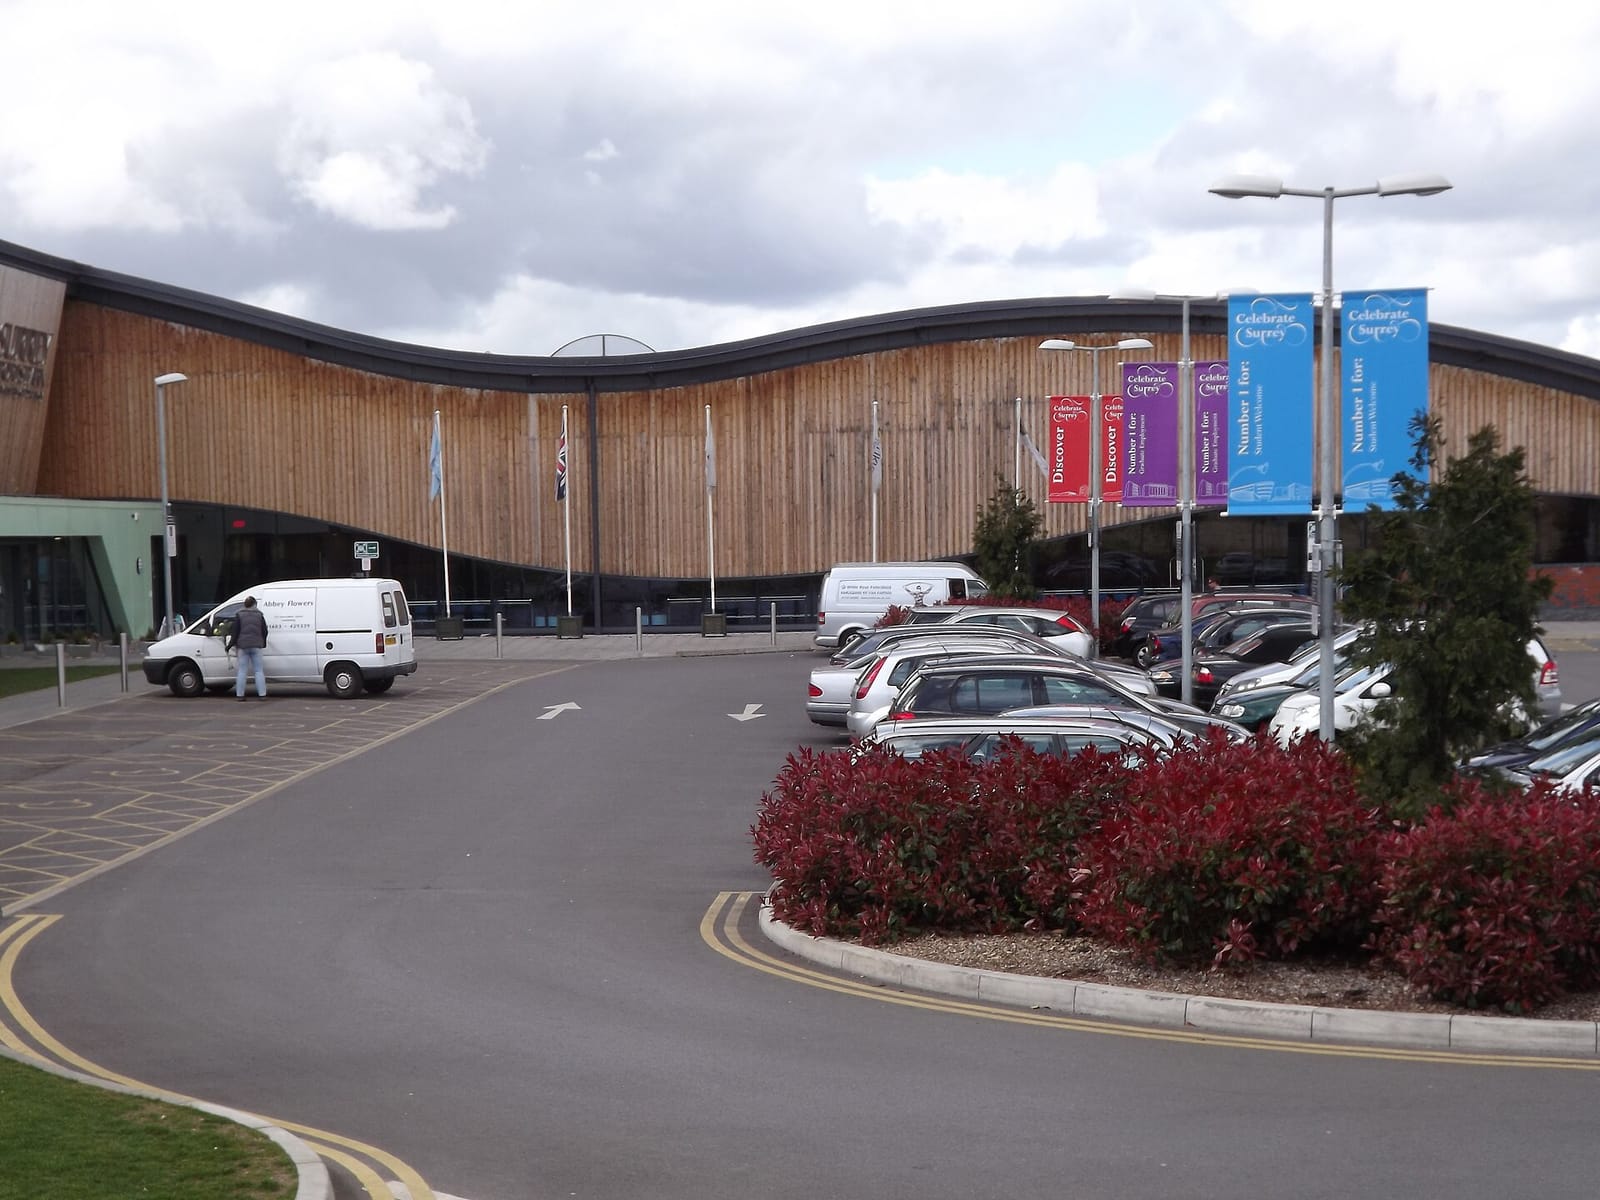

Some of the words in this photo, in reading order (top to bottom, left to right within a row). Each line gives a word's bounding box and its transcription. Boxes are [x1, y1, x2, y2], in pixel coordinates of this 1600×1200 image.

[1236, 314, 1296, 325] Celebrate
[1349, 310, 1410, 322] Celebrate
[1247, 328, 1286, 344] Surrey
[1359, 325, 1399, 341] Surrey
[1128, 375, 1167, 383] Celebrate
[1238, 361, 1250, 387] for:
[1352, 358, 1364, 384] for:
[1134, 385, 1160, 396] Surrey
[1254, 384, 1264, 423] Welcome
[1368, 382, 1377, 420] Welcome
[1059, 412, 1078, 421] Surrey
[1128, 413, 1137, 430] for:
[1201, 412, 1210, 428] for:
[1238, 401, 1250, 456] Number
[1352, 398, 1364, 453] Number
[1254, 425, 1264, 456] Student
[1368, 422, 1377, 453] Student
[1053, 427, 1065, 484] Discover
[1106, 426, 1117, 483] Discover
[1128, 439, 1137, 475] Number
[1201, 438, 1210, 473] Number
